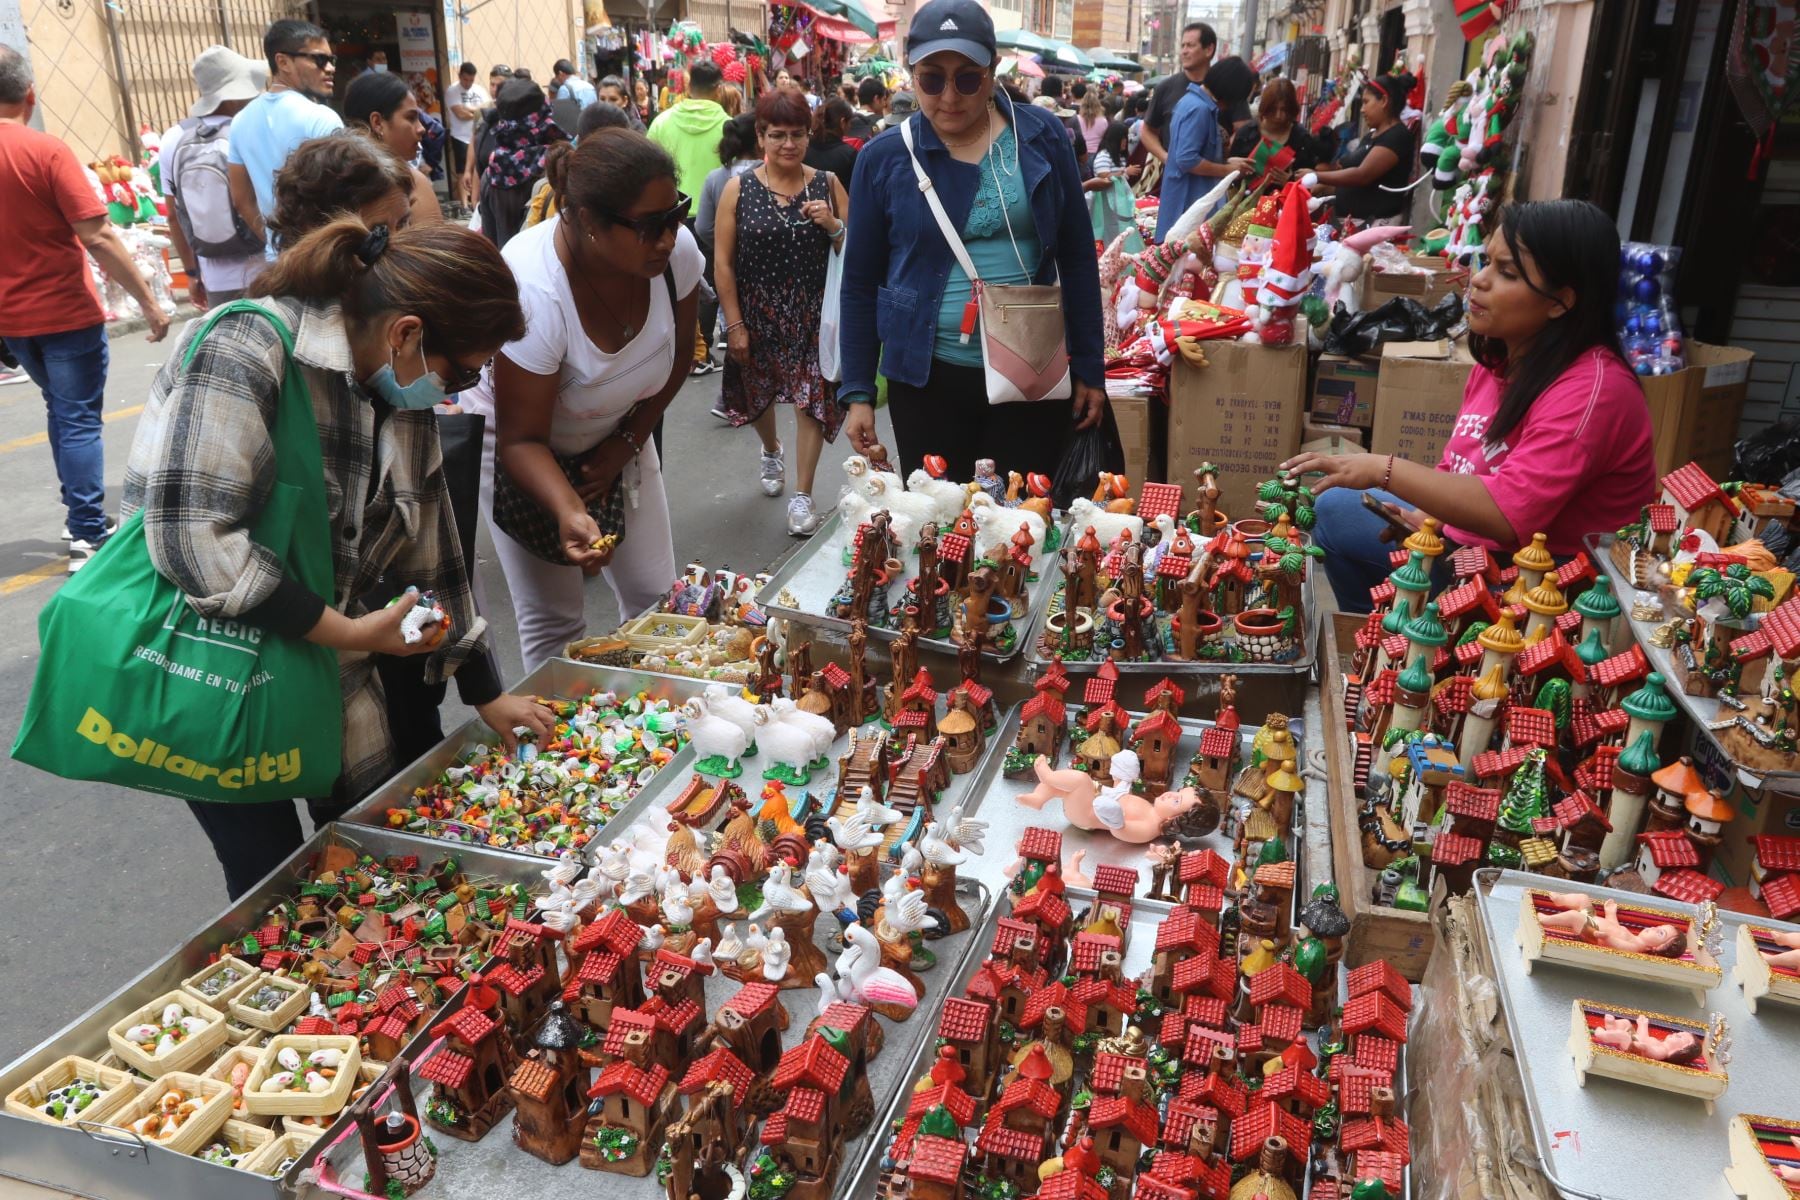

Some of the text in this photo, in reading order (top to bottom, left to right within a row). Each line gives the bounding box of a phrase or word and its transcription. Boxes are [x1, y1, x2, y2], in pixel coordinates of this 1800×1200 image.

[205, 672, 222, 688] EN
[224, 678, 240, 693] TU
[76, 706, 301, 790] Dollarcity
